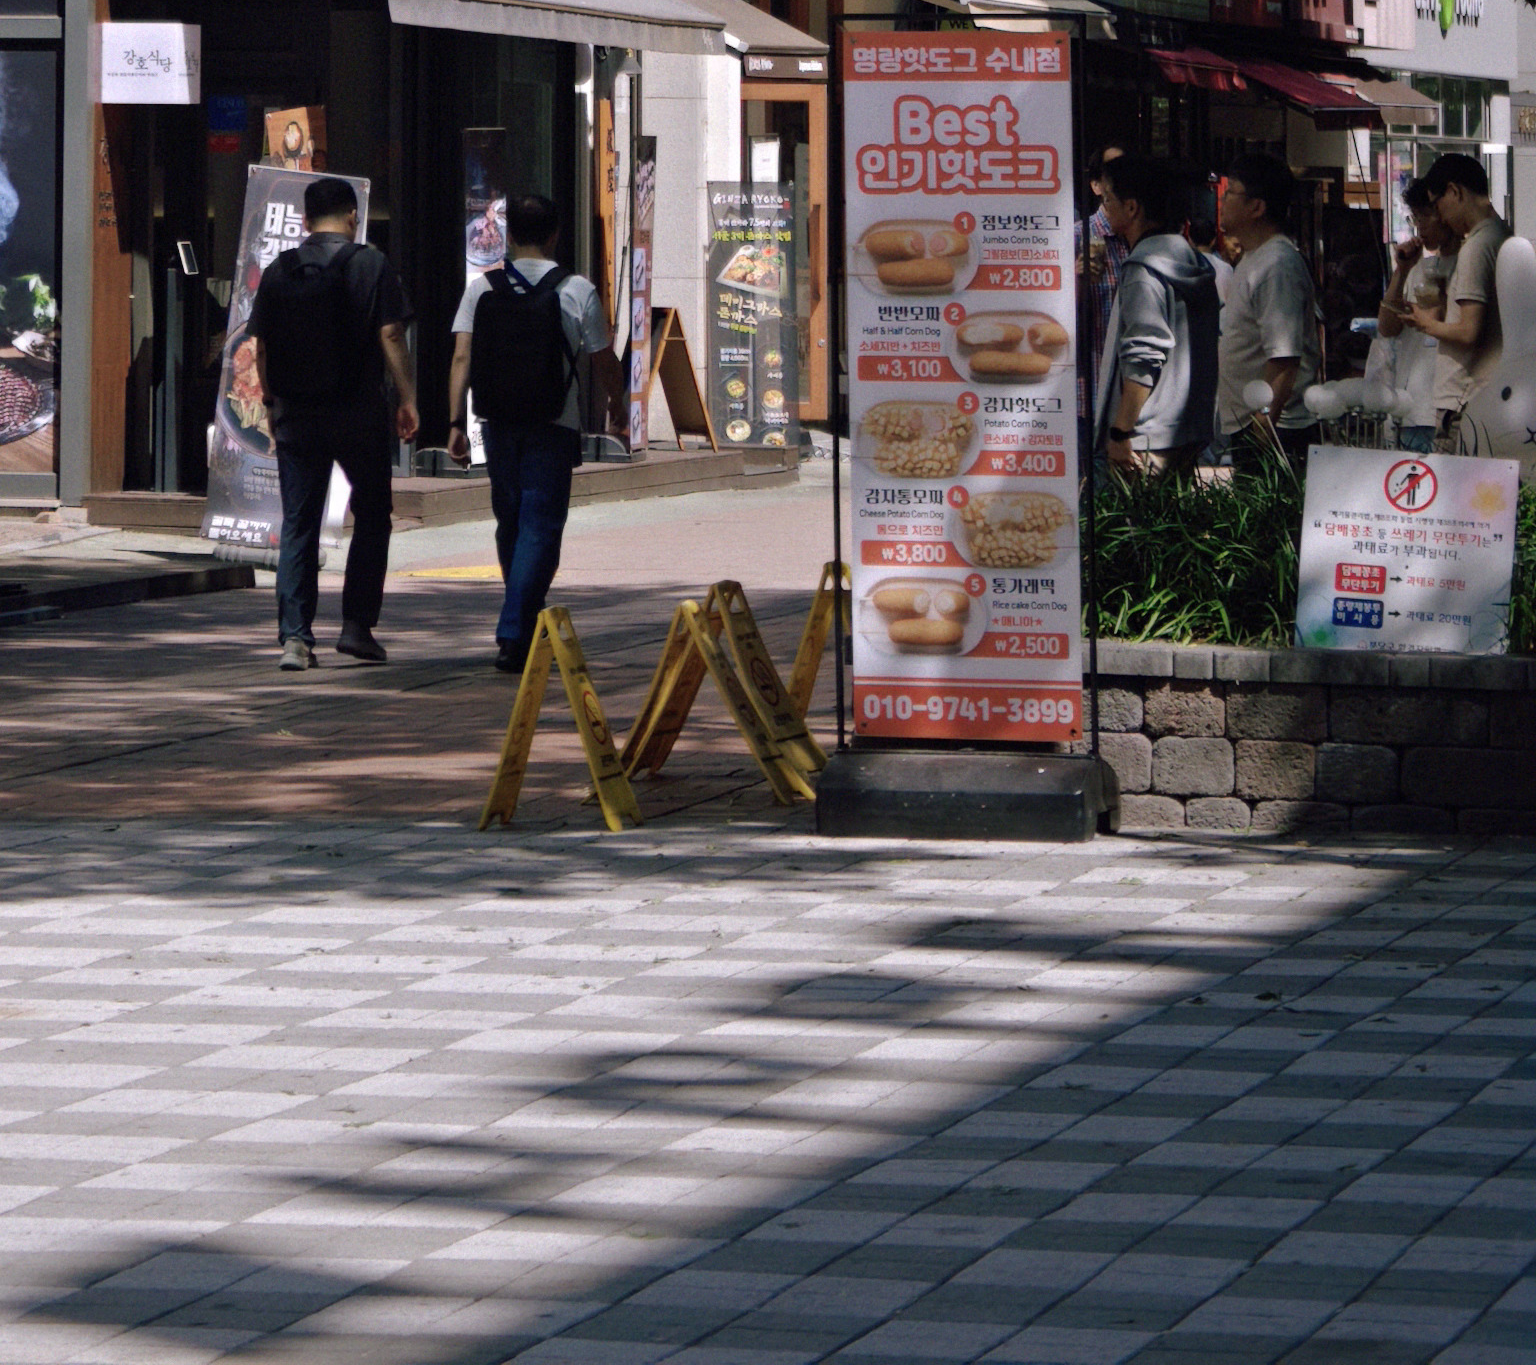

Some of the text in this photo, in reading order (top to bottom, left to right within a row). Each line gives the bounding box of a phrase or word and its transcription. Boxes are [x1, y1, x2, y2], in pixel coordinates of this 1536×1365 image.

[122, 48, 173, 74] 강호식당
[851, 46, 1062, 74] 명랑핫도그 수내점
[897, 98, 1016, 147] Best
[861, 148, 1058, 191] 인기핫도그
[980, 214, 1061, 232] 점보핫도그
[981, 234, 1049, 247] Jumbo Corn Dog
[905, 326, 923, 337] Corn
[924, 326, 941, 338] Dog
[983, 396, 1063, 415] 감자핫도그
[984, 419, 1048, 430] Potato Corn Dog
[1390, 528, 1428, 543] 쓰레기
[1352, 540, 1400, 556] 과태료가
[991, 577, 1055, 596] 통가래떡
[992, 600, 1067, 612] Rice cake Corn Dog
[863, 693, 1074, 724] 010-9741-3899
